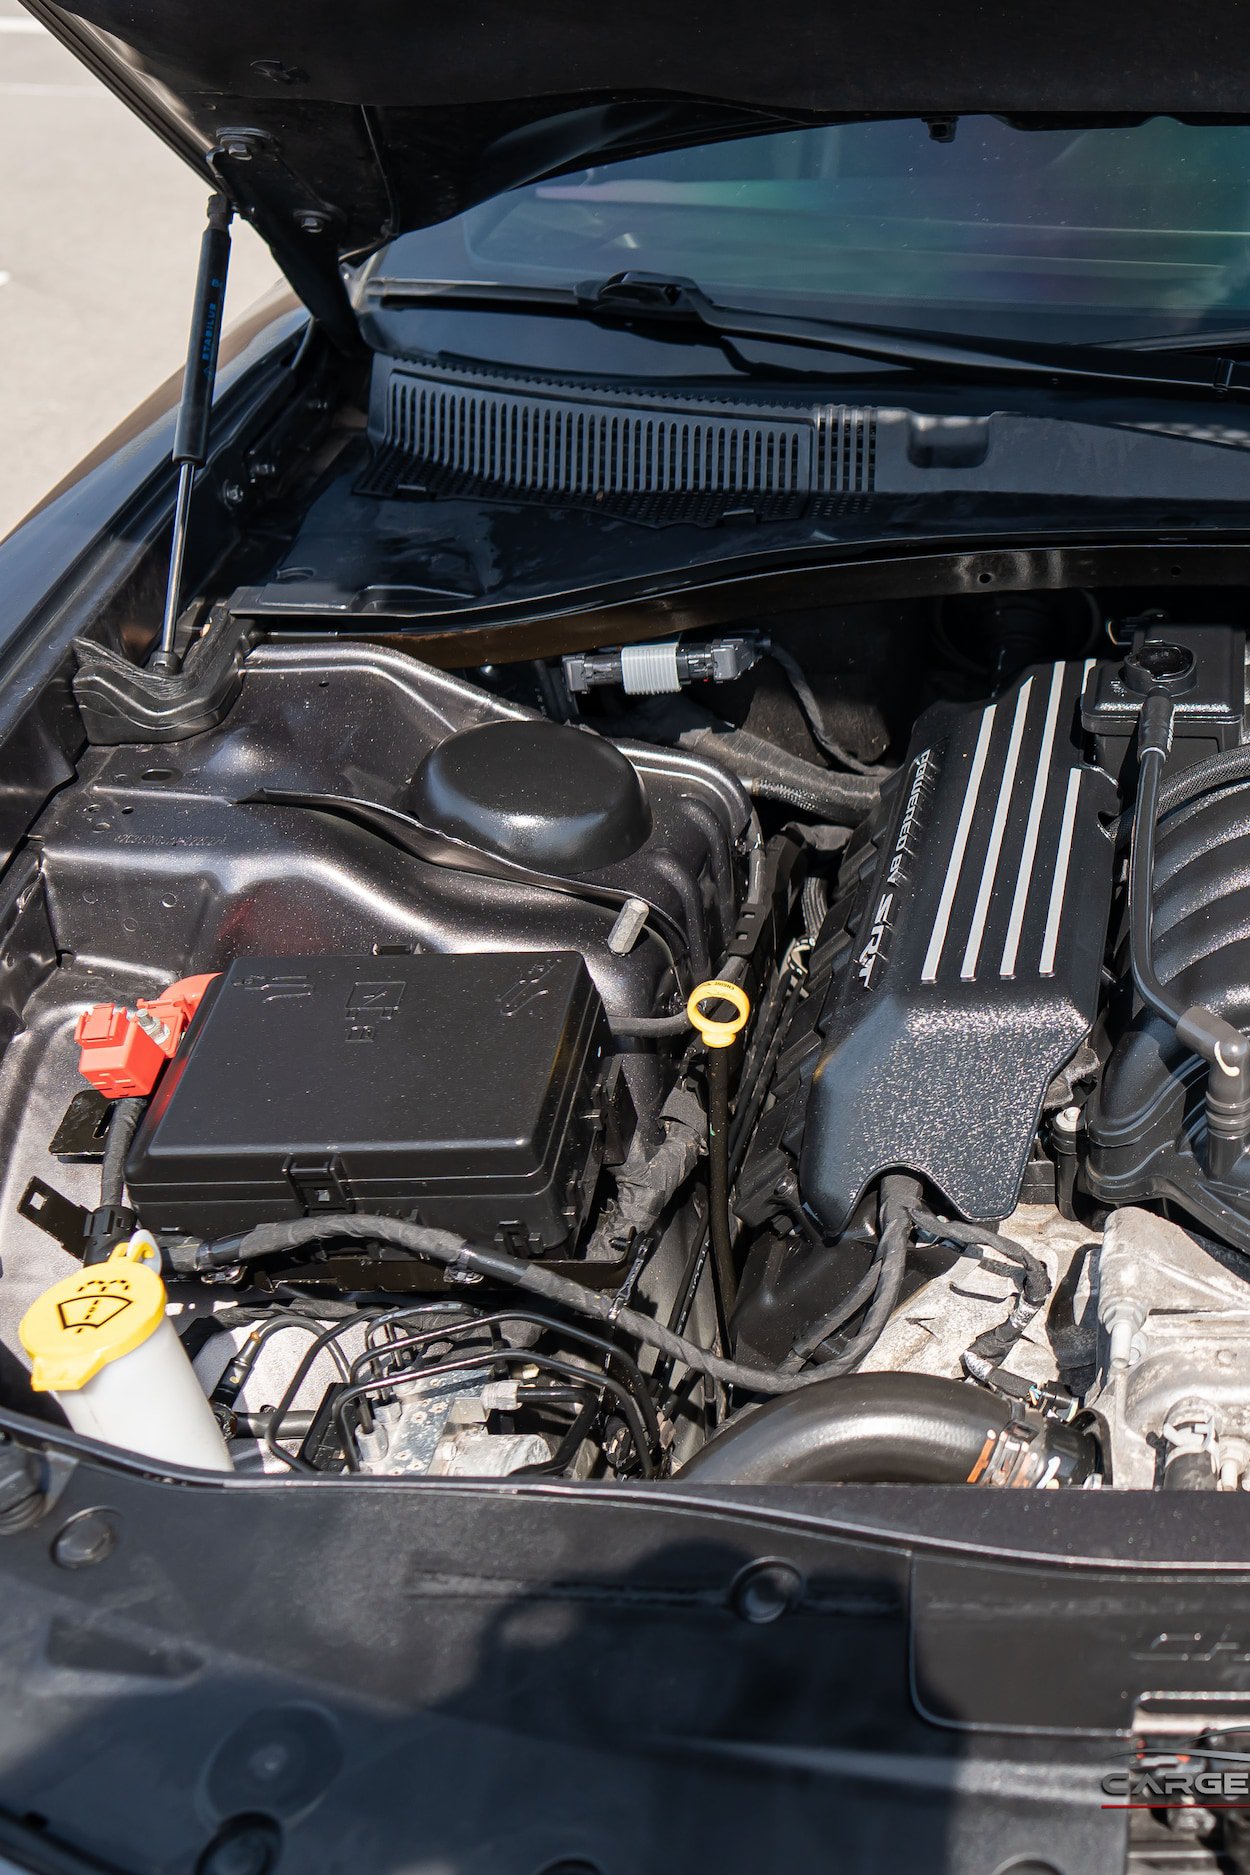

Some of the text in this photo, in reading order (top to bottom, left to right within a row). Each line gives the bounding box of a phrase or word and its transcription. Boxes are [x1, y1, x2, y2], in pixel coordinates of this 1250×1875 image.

[202, 302, 217, 360] STABILUS
[857, 749, 931, 987] POWERED BY SRT
